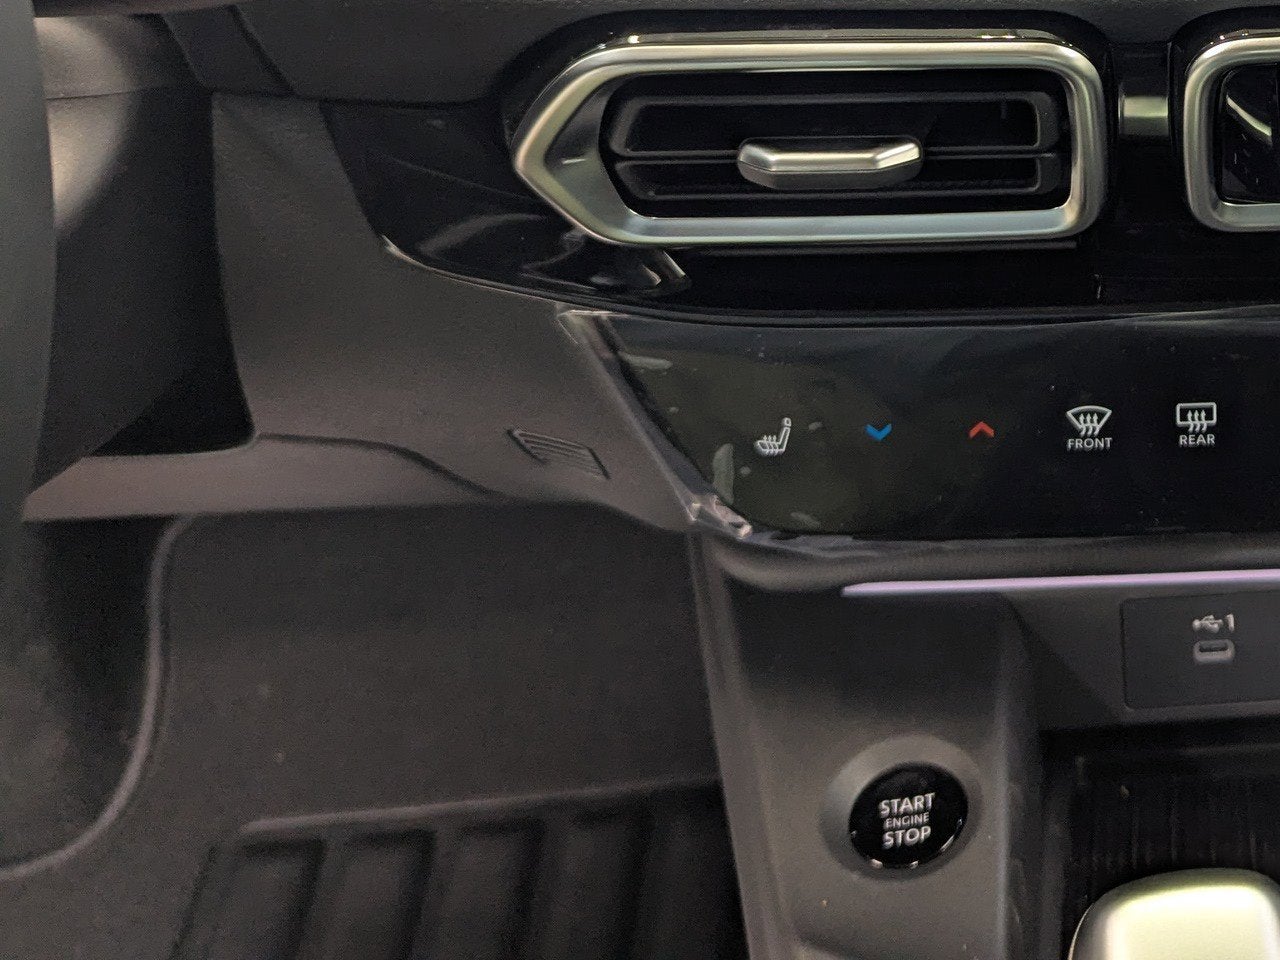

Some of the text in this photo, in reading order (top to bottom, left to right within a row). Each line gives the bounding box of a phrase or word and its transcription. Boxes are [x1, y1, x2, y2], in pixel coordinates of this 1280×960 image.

[1066, 437, 1113, 451] FRONT
[1179, 434, 1215, 446] REAR
[1225, 613, 1235, 633] 1
[879, 792, 936, 818] START
[884, 812, 930, 829] ENGINE
[882, 826, 932, 849] STOP
